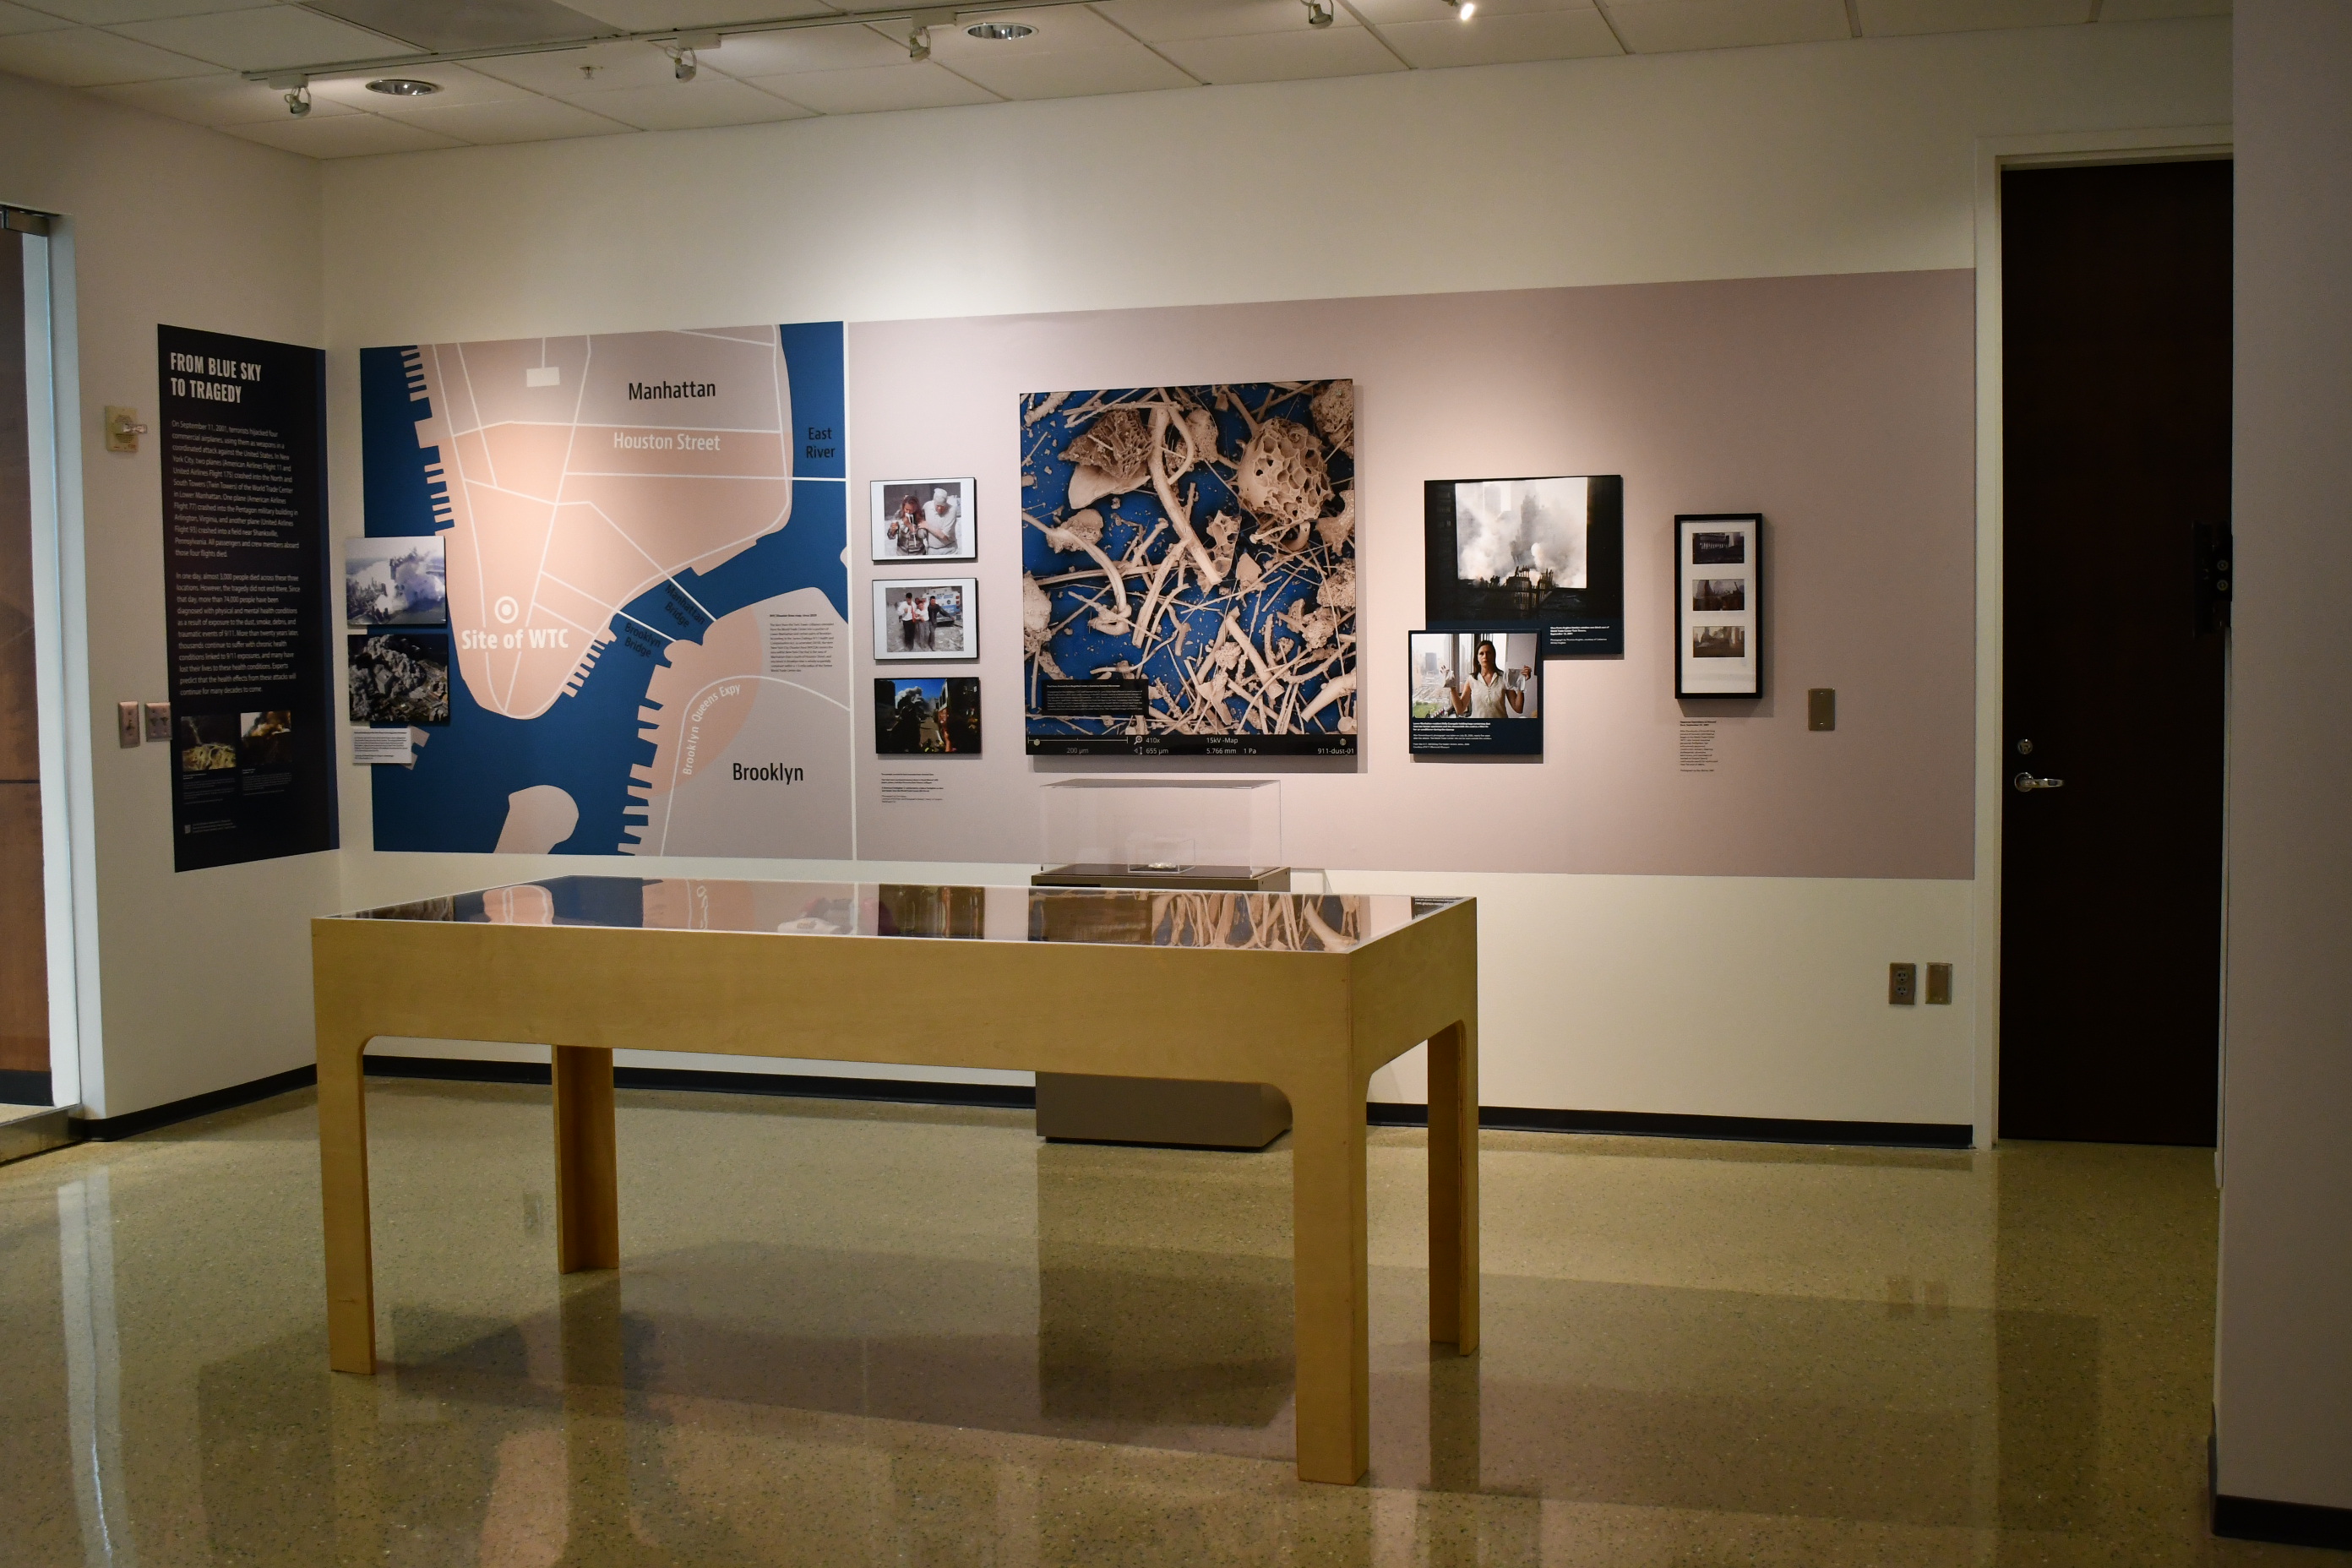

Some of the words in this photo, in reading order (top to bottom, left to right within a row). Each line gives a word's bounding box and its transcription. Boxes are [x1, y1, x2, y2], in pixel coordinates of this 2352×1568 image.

[171, 352, 204, 374] FROM
[209, 357, 237, 378] BLUE
[241, 362, 261, 381] SKY
[171, 378, 186, 396] TO
[190, 380, 242, 403] TRAGEDY
[629, 381, 716, 400] Manhattan
[613, 433, 672, 449] Houston
[677, 433, 721, 451] Street
[808, 427, 831, 440] East
[806, 446, 835, 458] River
[664, 602, 689, 628] Bridge
[665, 585, 705, 624] Manhattan
[461, 629, 498, 650] Site
[503, 629, 523, 649] of
[529, 629, 569, 649] WTC
[624, 623, 662, 647] Brooklyn
[624, 637, 651, 657] Bridge
[719, 684, 741, 697] Expy
[691, 692, 719, 722] Queens
[683, 727, 700, 776] Brooklyn
[732, 762, 803, 785] Brooklyn
